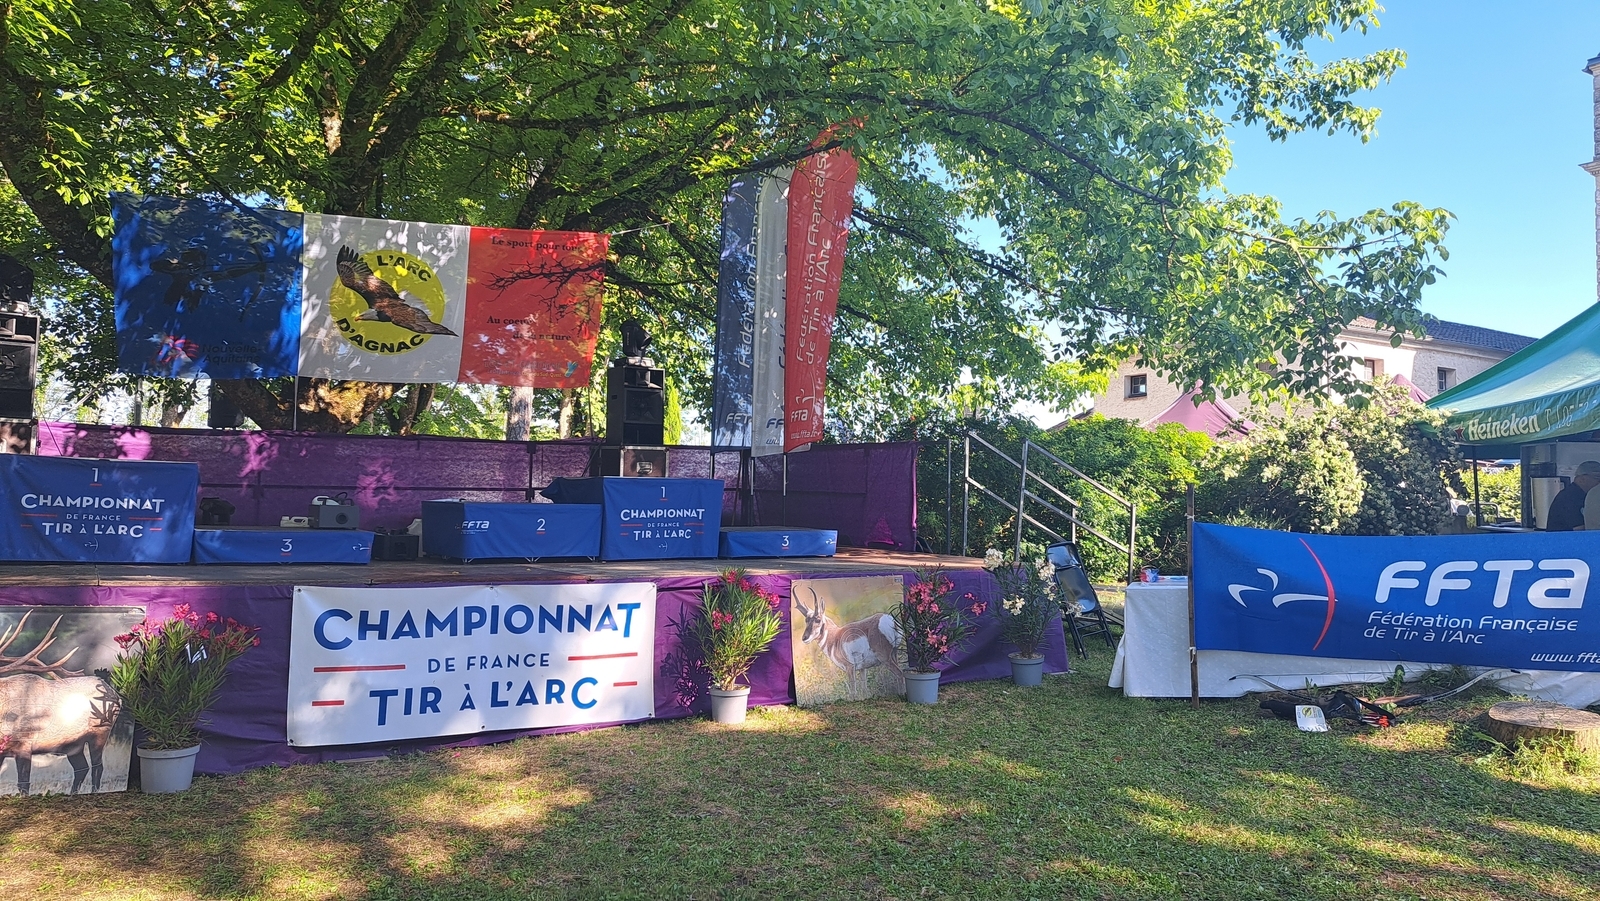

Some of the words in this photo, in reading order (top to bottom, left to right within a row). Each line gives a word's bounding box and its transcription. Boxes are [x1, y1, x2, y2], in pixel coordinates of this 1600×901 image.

[491, 236, 504, 245] Le
[506, 240, 534, 248] sport
[535, 242, 560, 251] pour
[376, 254, 431, 282] L'ARC
[814, 238, 832, 284] l'Arc
[812, 289, 825, 302] à
[486, 315, 500, 324] Au
[808, 307, 821, 334] Tir
[336, 317, 425, 353] D'AGNAC
[203, 353, 260, 365] Aquitaine
[805, 341, 817, 364] de
[1468, 413, 1541, 441] Heineken
[91, 467, 99, 482] 1
[660, 486, 666, 498] 1
[20, 493, 165, 513] CHAMPIONNAT
[620, 508, 705, 521] CHAMPIONNAT
[42, 522, 73, 536] TIR
[79, 524, 87, 534] À
[94, 524, 144, 538] L'ARC
[536, 518, 546, 531] 2
[633, 530, 652, 541] TIR
[655, 530, 660, 538] À
[664, 529, 692, 539] L'ARC
[781, 535, 790, 547] 3
[281, 538, 293, 552] 3
[313, 602, 642, 651] CHAMPIONNAT
[1367, 611, 1473, 629] Fédération
[1479, 615, 1579, 633] Française
[1363, 625, 1387, 639] de
[1393, 628, 1419, 641] Tir
[1423, 629, 1436, 642] à
[1441, 630, 1485, 645] l'Arc
[428, 657, 456, 673] DE
[466, 653, 551, 672] FRANCE
[369, 686, 443, 727] TIR
[458, 683, 476, 711] À
[490, 677, 599, 710] L'ARC
